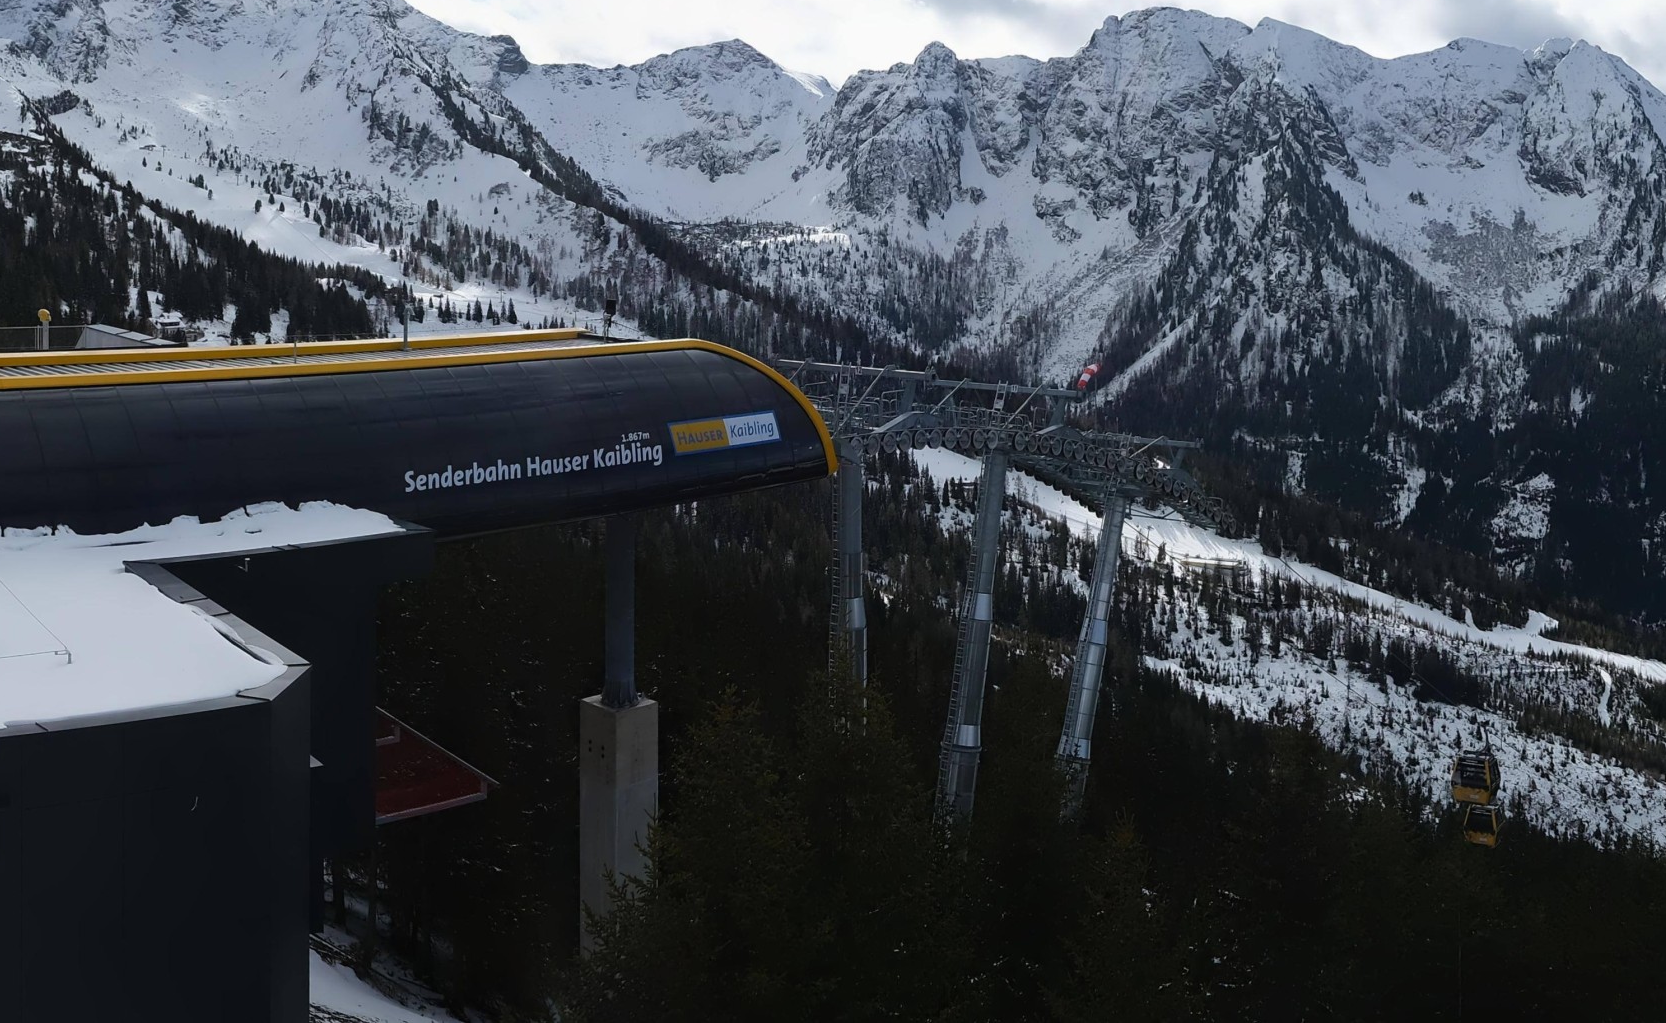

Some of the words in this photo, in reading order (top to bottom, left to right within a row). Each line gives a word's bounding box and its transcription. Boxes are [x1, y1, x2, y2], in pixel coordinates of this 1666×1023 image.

[621, 430, 650, 443] 1.867m
[677, 430, 723, 445] HAUSER
[730, 421, 774, 437] Kaibling
[404, 459, 522, 493] Senderbahn
[526, 452, 589, 477] Hauser
[593, 442, 663, 468] Kaibling
